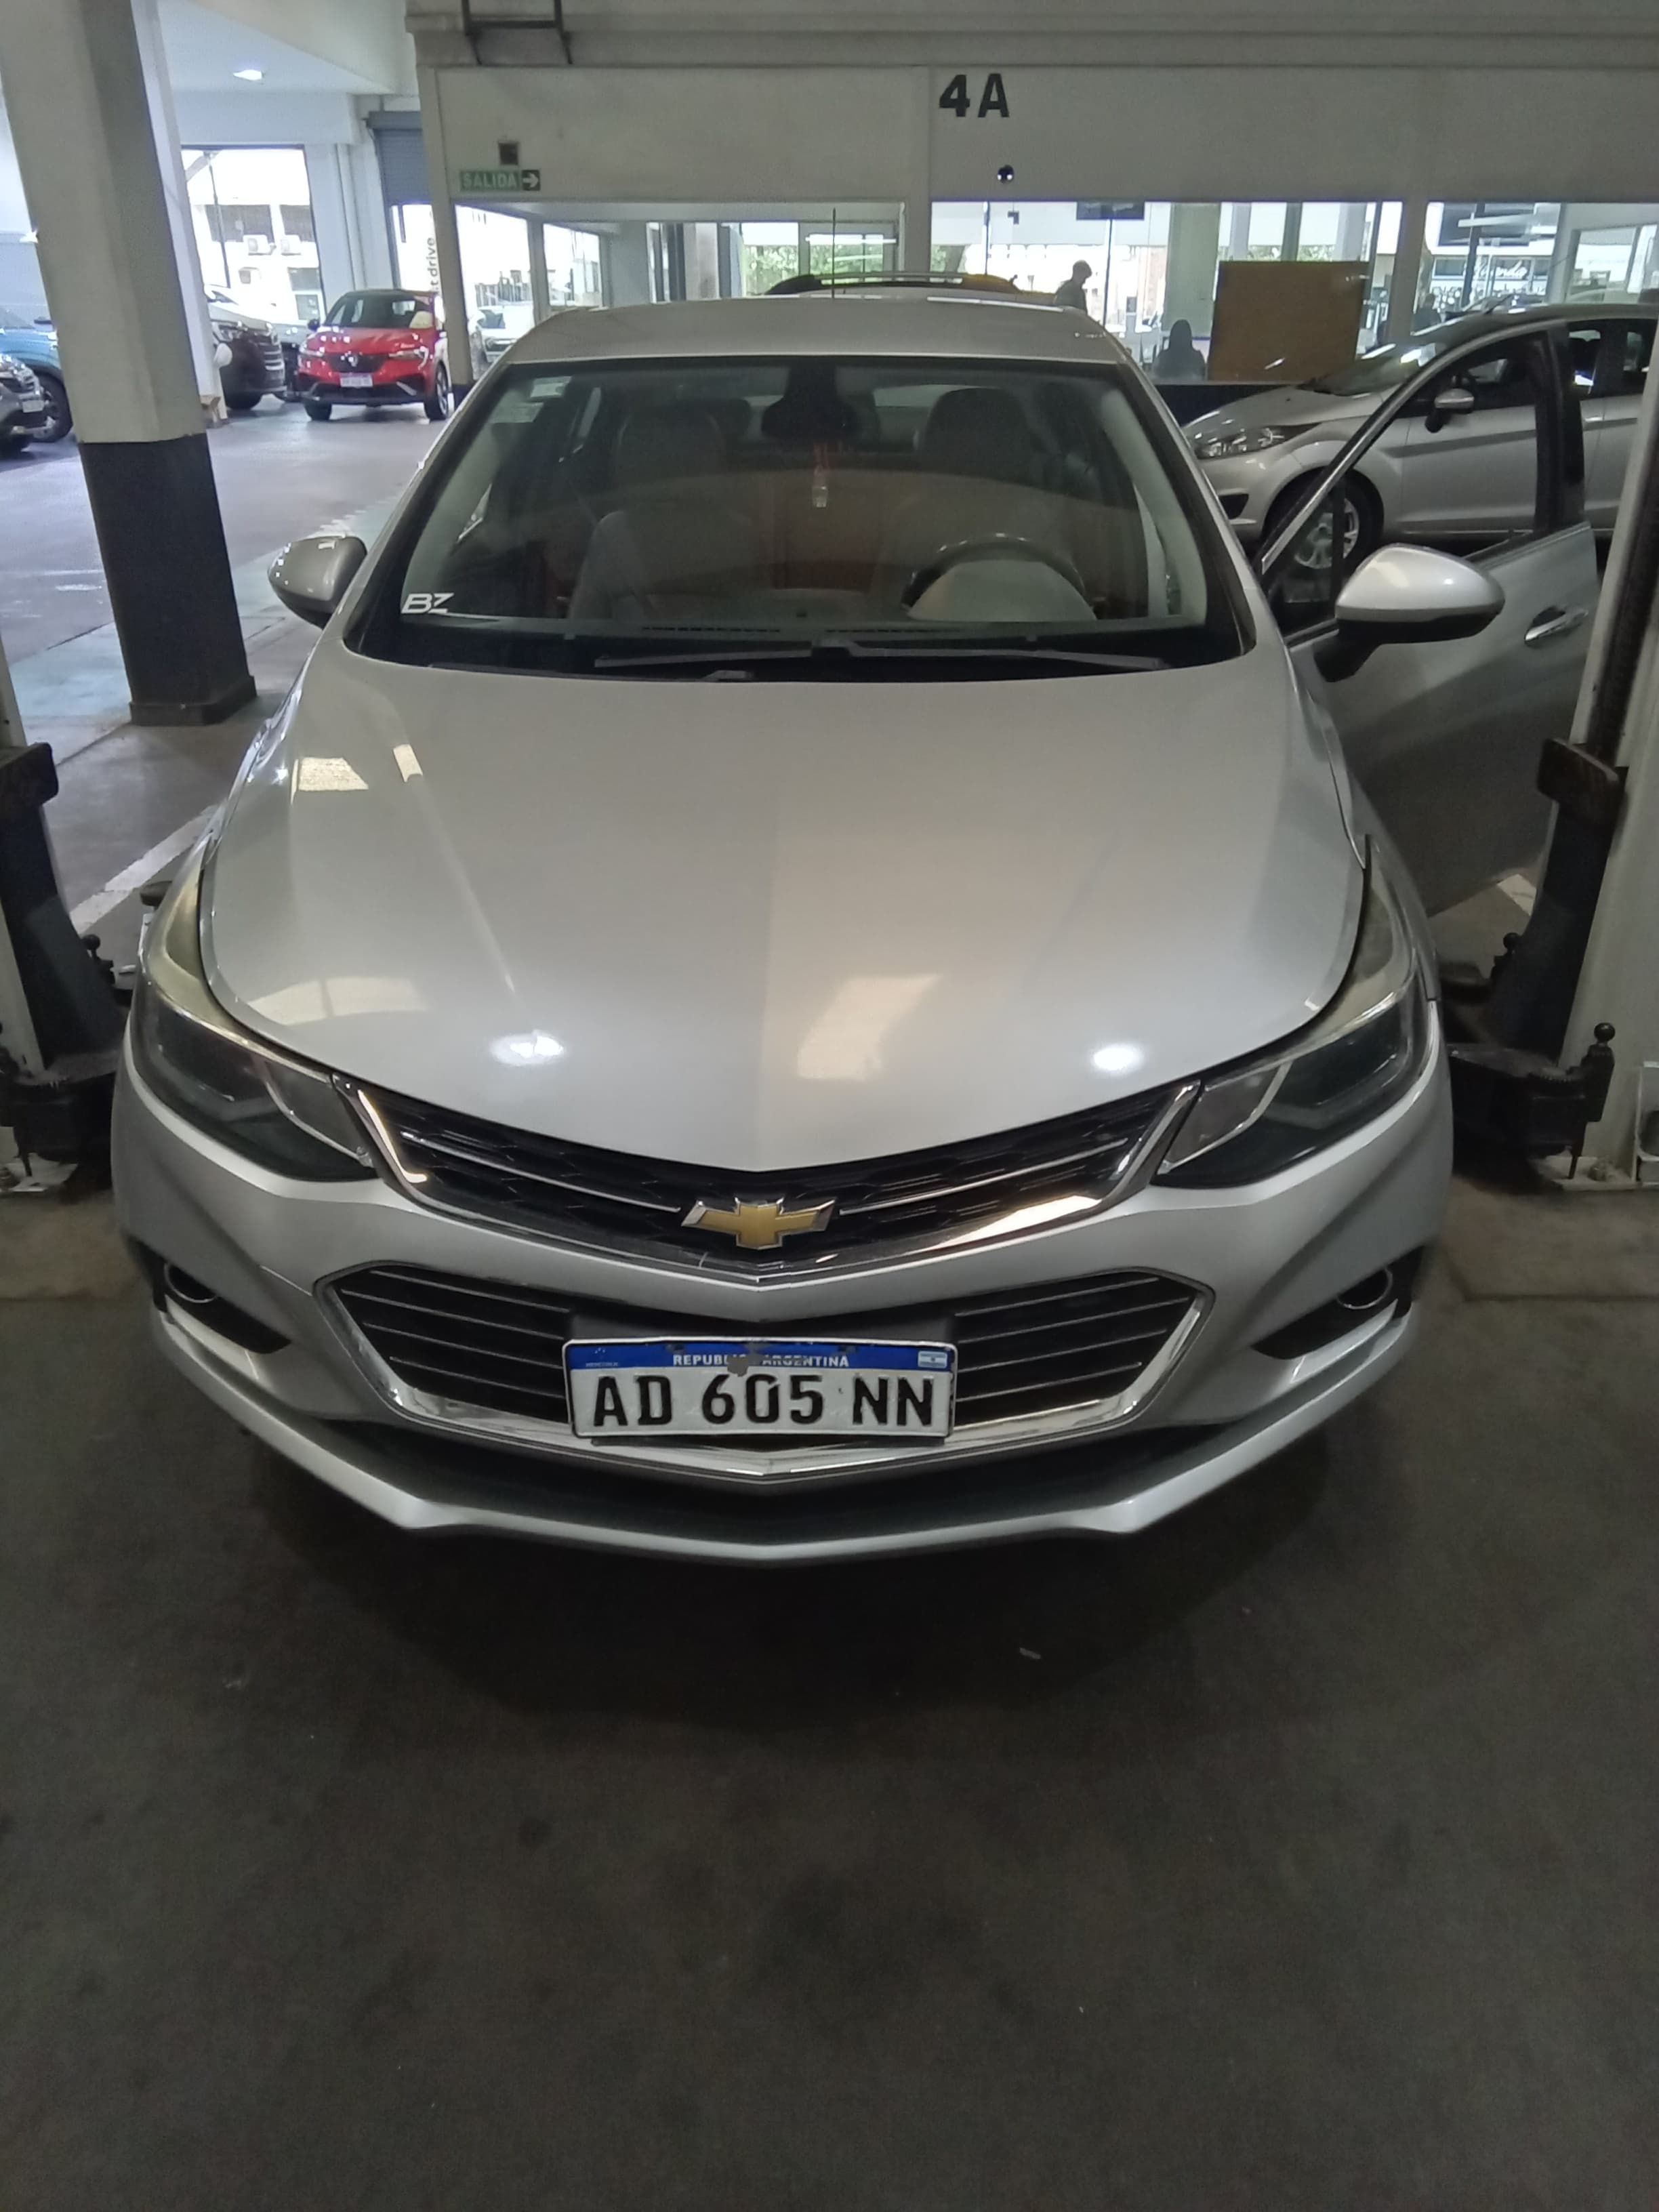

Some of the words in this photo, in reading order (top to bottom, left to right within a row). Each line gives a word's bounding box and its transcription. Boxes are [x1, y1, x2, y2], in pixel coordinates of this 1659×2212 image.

[462, 172, 518, 188] SALIDA
[426, 237, 438, 276] drive
[401, 592, 455, 614] BZ
[762, 1355, 849, 1368] ARGENTINA
[593, 1374, 672, 1427] AD
[702, 1373, 823, 1425] 605
[853, 1376, 935, 1427] NN
